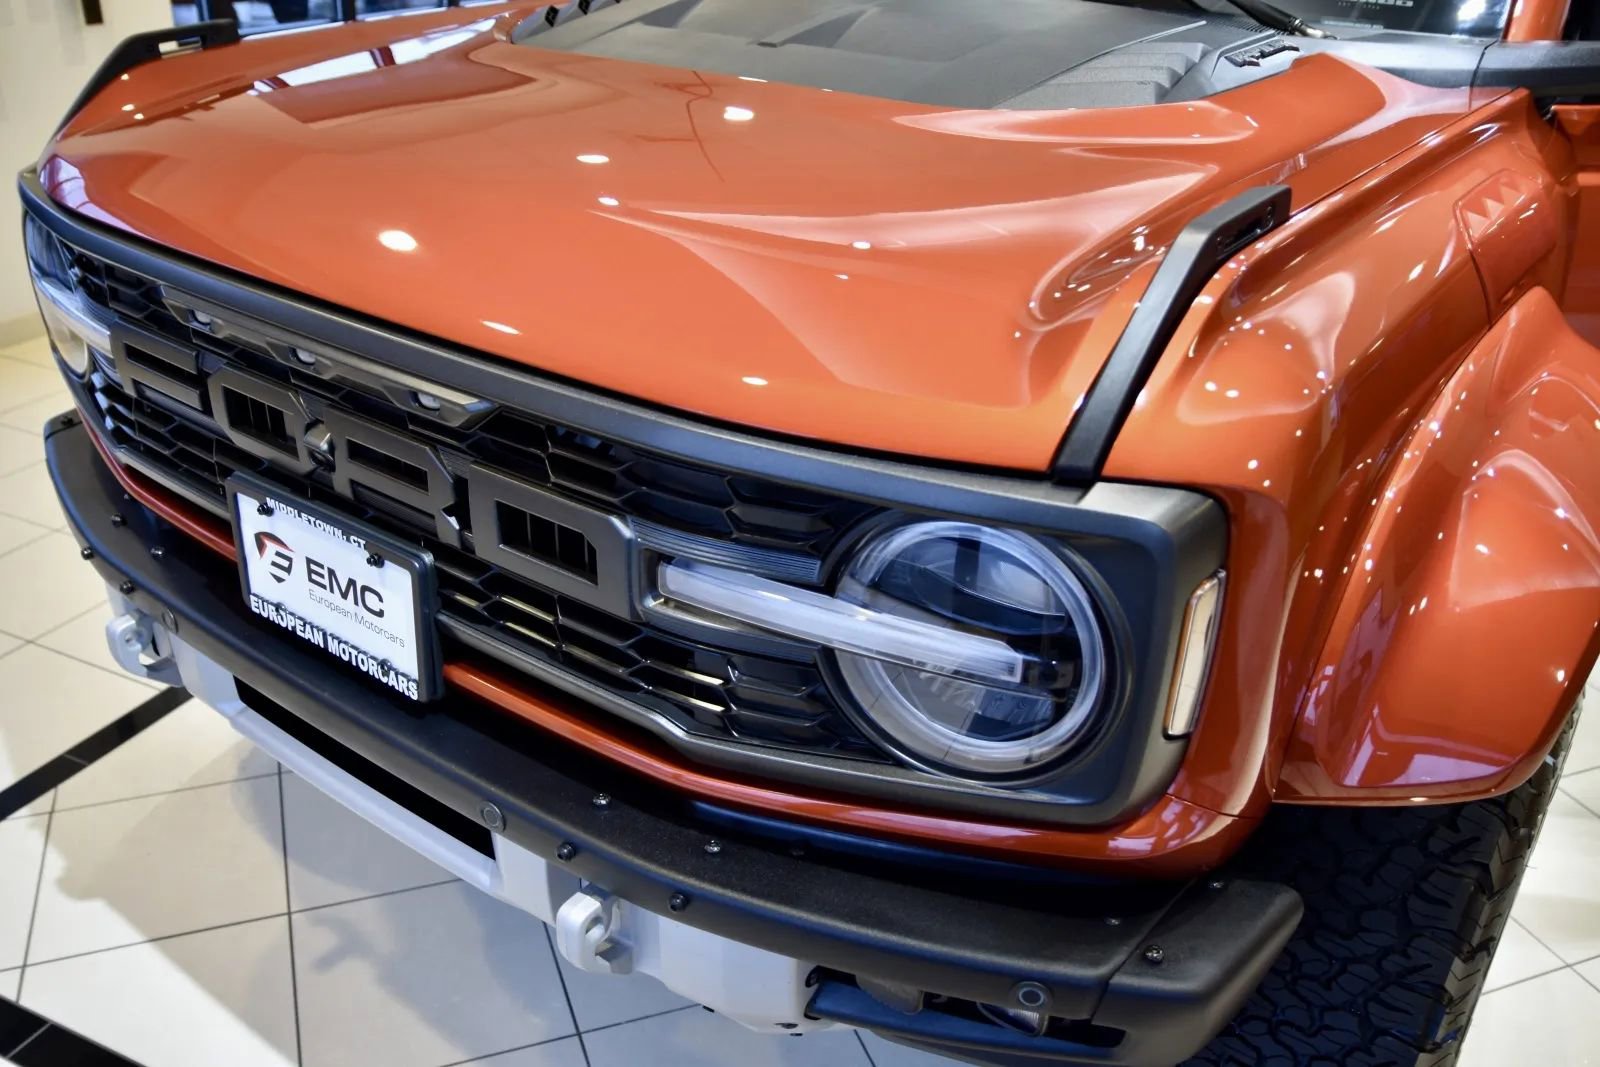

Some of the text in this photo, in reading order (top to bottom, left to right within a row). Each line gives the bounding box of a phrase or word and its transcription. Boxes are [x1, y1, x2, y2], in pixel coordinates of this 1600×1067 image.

[110, 319, 638, 618] FORD
[350, 535, 366, 548] CT
[305, 556, 385, 619] EMC
[308, 588, 406, 648] European Motorcars
[249, 594, 419, 701] EUROPEAN MOTORCARS
